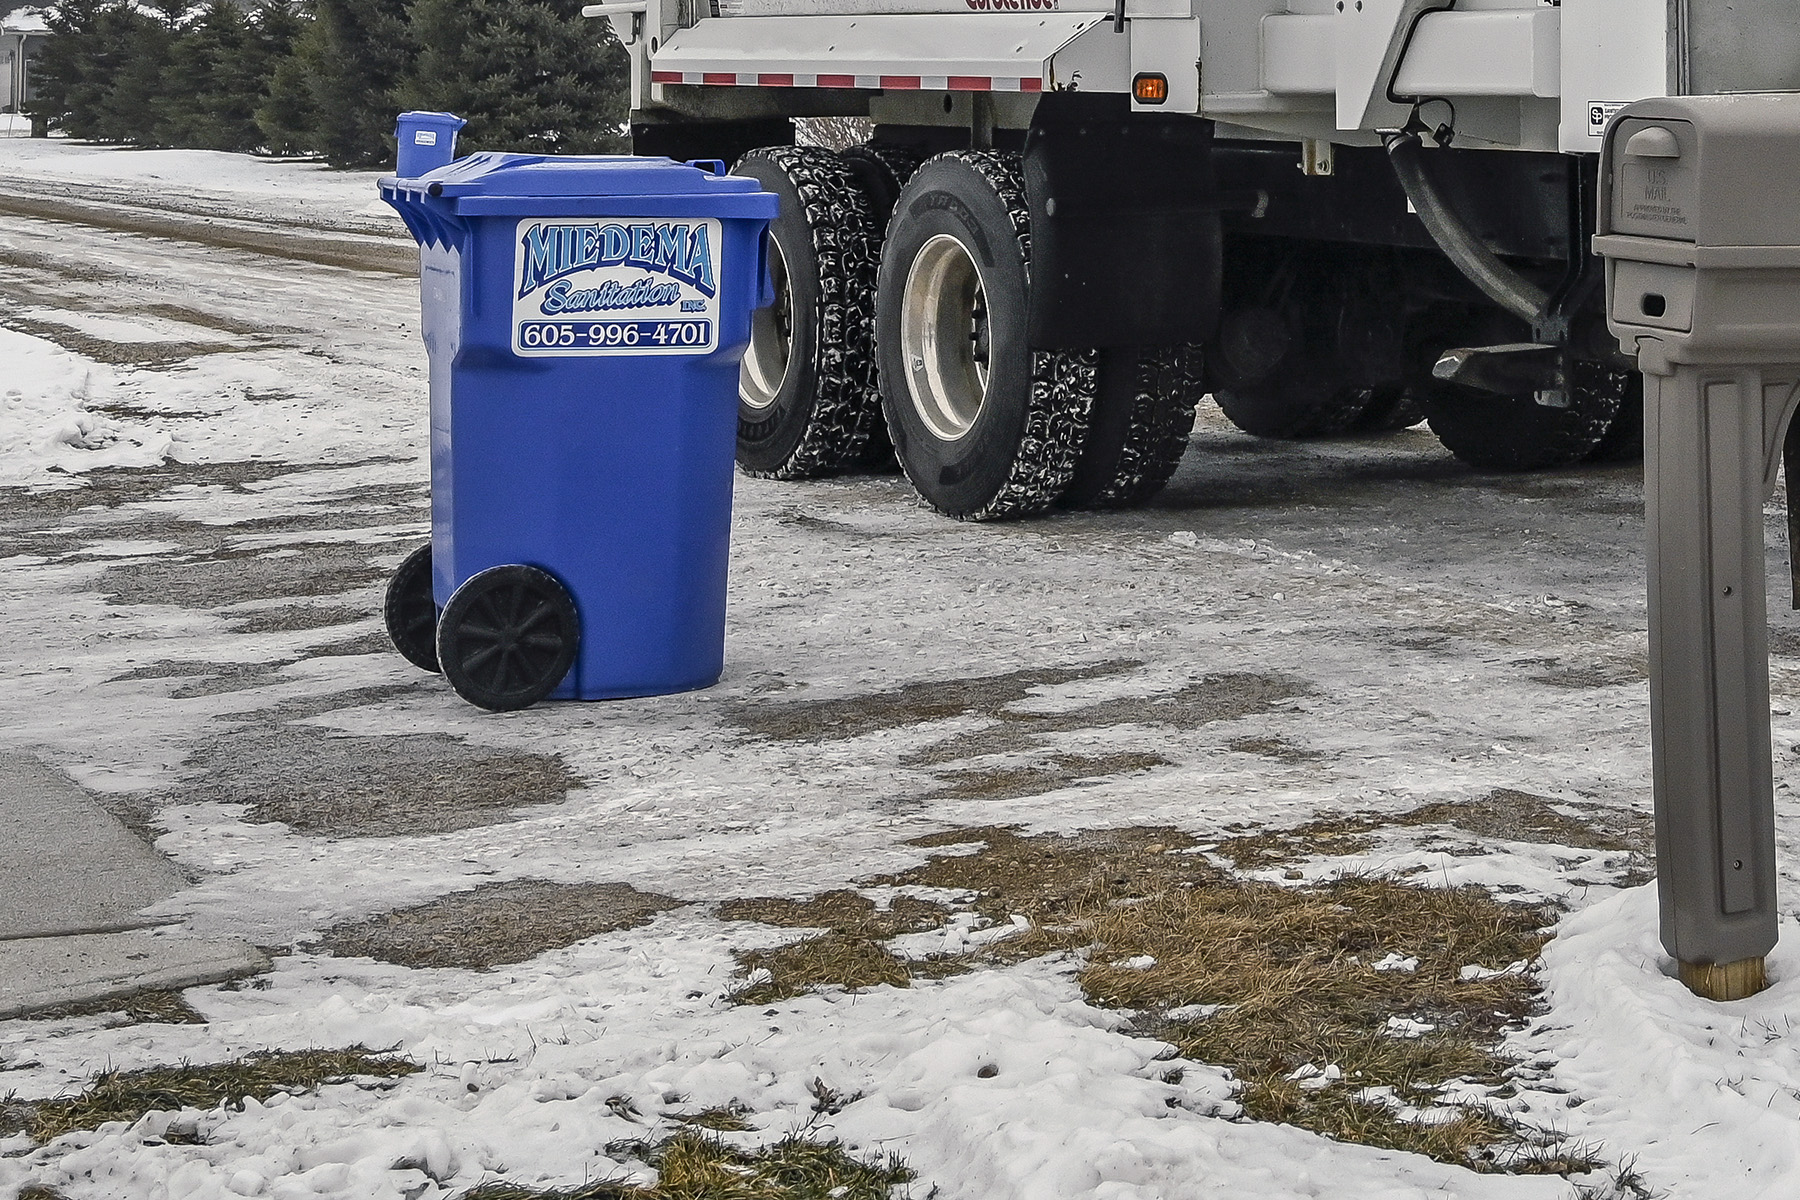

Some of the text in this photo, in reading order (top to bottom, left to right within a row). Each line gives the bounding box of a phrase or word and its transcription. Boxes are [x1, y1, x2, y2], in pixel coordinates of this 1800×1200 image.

[518, 222, 716, 301] MIEDEMA
[540, 277, 681, 316] Sanitation
[523, 322, 707, 347] 605-996-4701
